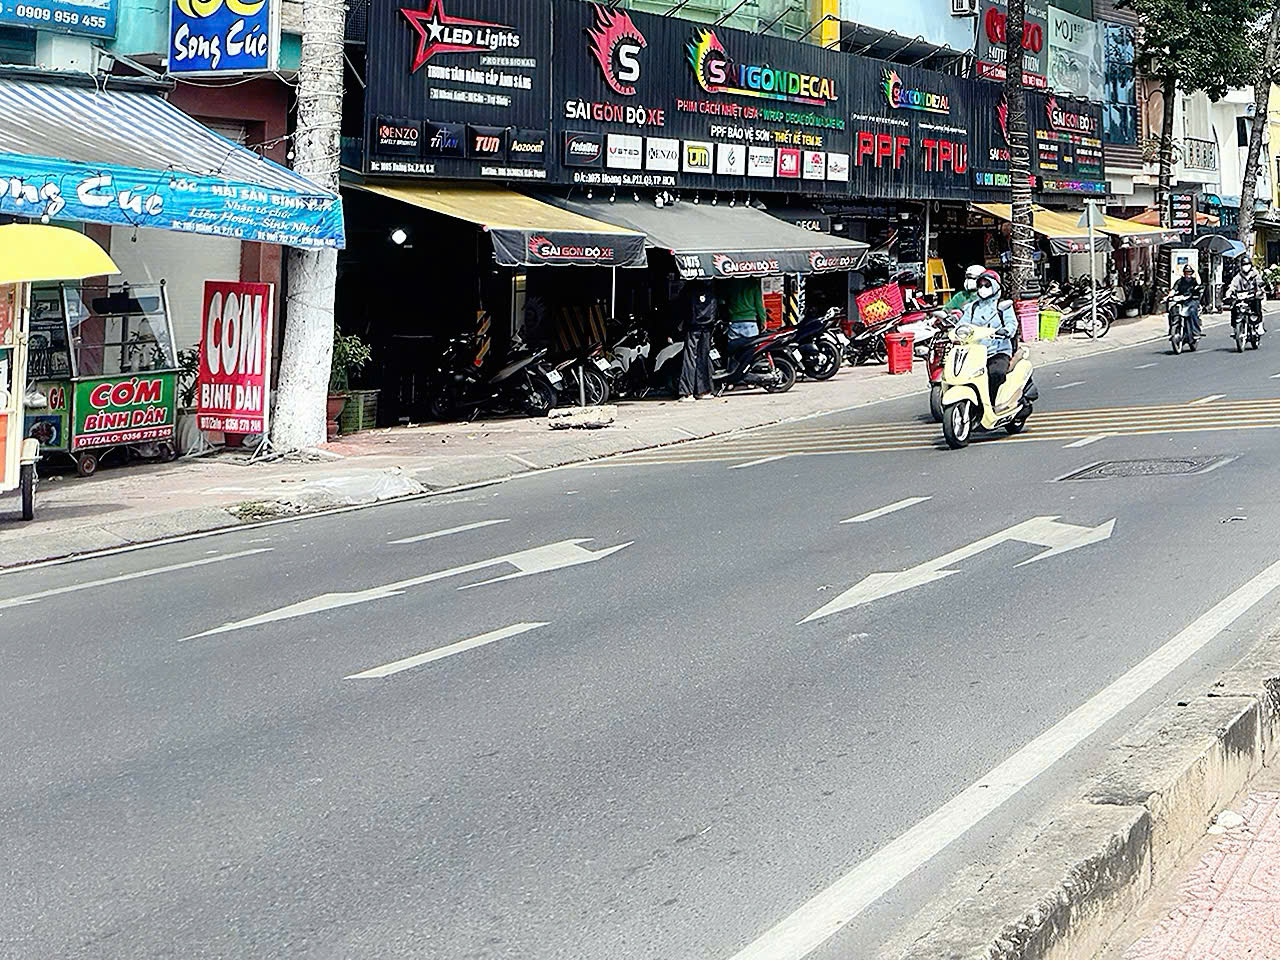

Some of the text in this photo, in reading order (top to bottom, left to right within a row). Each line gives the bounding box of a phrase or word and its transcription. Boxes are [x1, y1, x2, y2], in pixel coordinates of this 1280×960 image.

[16, 5, 51, 21] 0909
[54, 11, 79, 25] 959
[82, 16, 106, 29] 455
[174, 18, 268, 70] Song Cúc
[443, 27, 520, 50] LED Lights
[619, 44, 640, 82] S
[565, 99, 665, 128] SÀI GÒN ĐỘ XE
[677, 100, 697, 113] PHIM
[699, 99, 720, 115] CÁCH
[380, 125, 419, 140] KENZO
[711, 125, 728, 138] PPF
[782, 153, 797, 171] 3M
[855, 130, 910, 169] PPF
[921, 137, 967, 173] TPU
[76, 175, 165, 217] Cúc
[541, 245, 614, 258] SÀI GÒN ĐỘ XE
[207, 291, 263, 375] CƠM
[90, 377, 163, 408] CƠM
[202, 378, 233, 410] BÌNH
[84, 405, 167, 432] BÌNH DÂN
[122, 431, 141, 441] 0356
